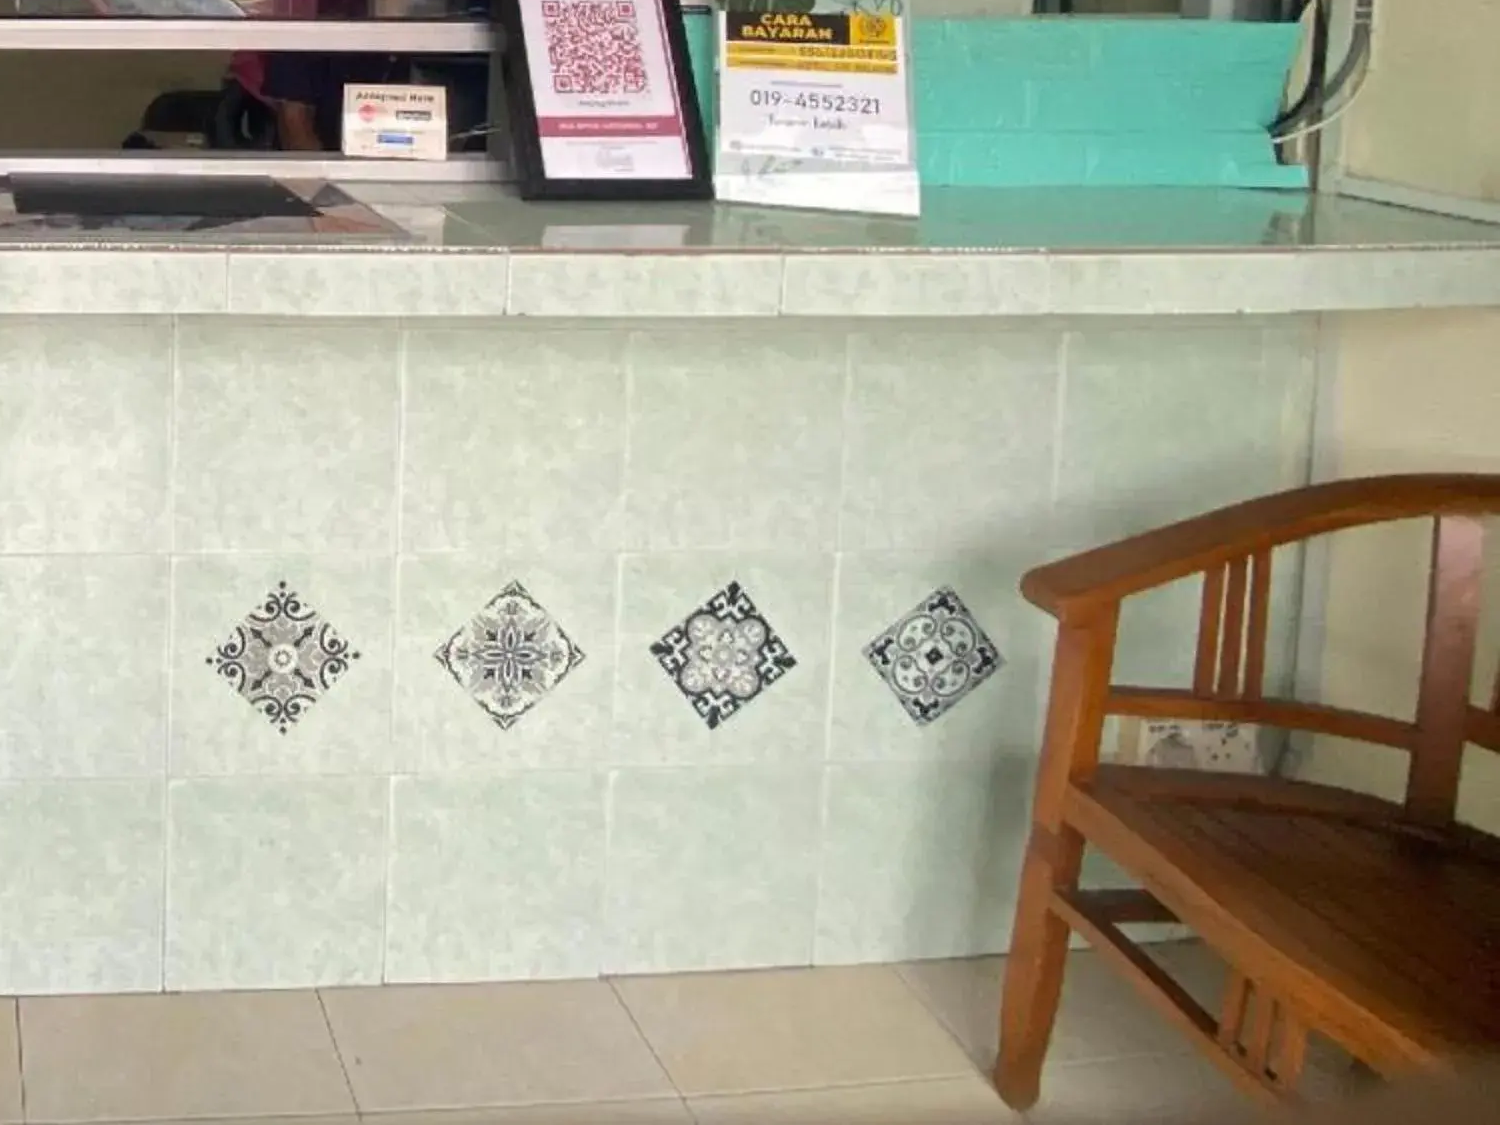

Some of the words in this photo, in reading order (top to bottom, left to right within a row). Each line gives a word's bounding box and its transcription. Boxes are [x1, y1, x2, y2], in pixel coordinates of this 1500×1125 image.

[760, 13, 813, 27] CARA
[741, 25, 834, 41] BAYARAN
[750, 89, 881, 115] 019-4552321
